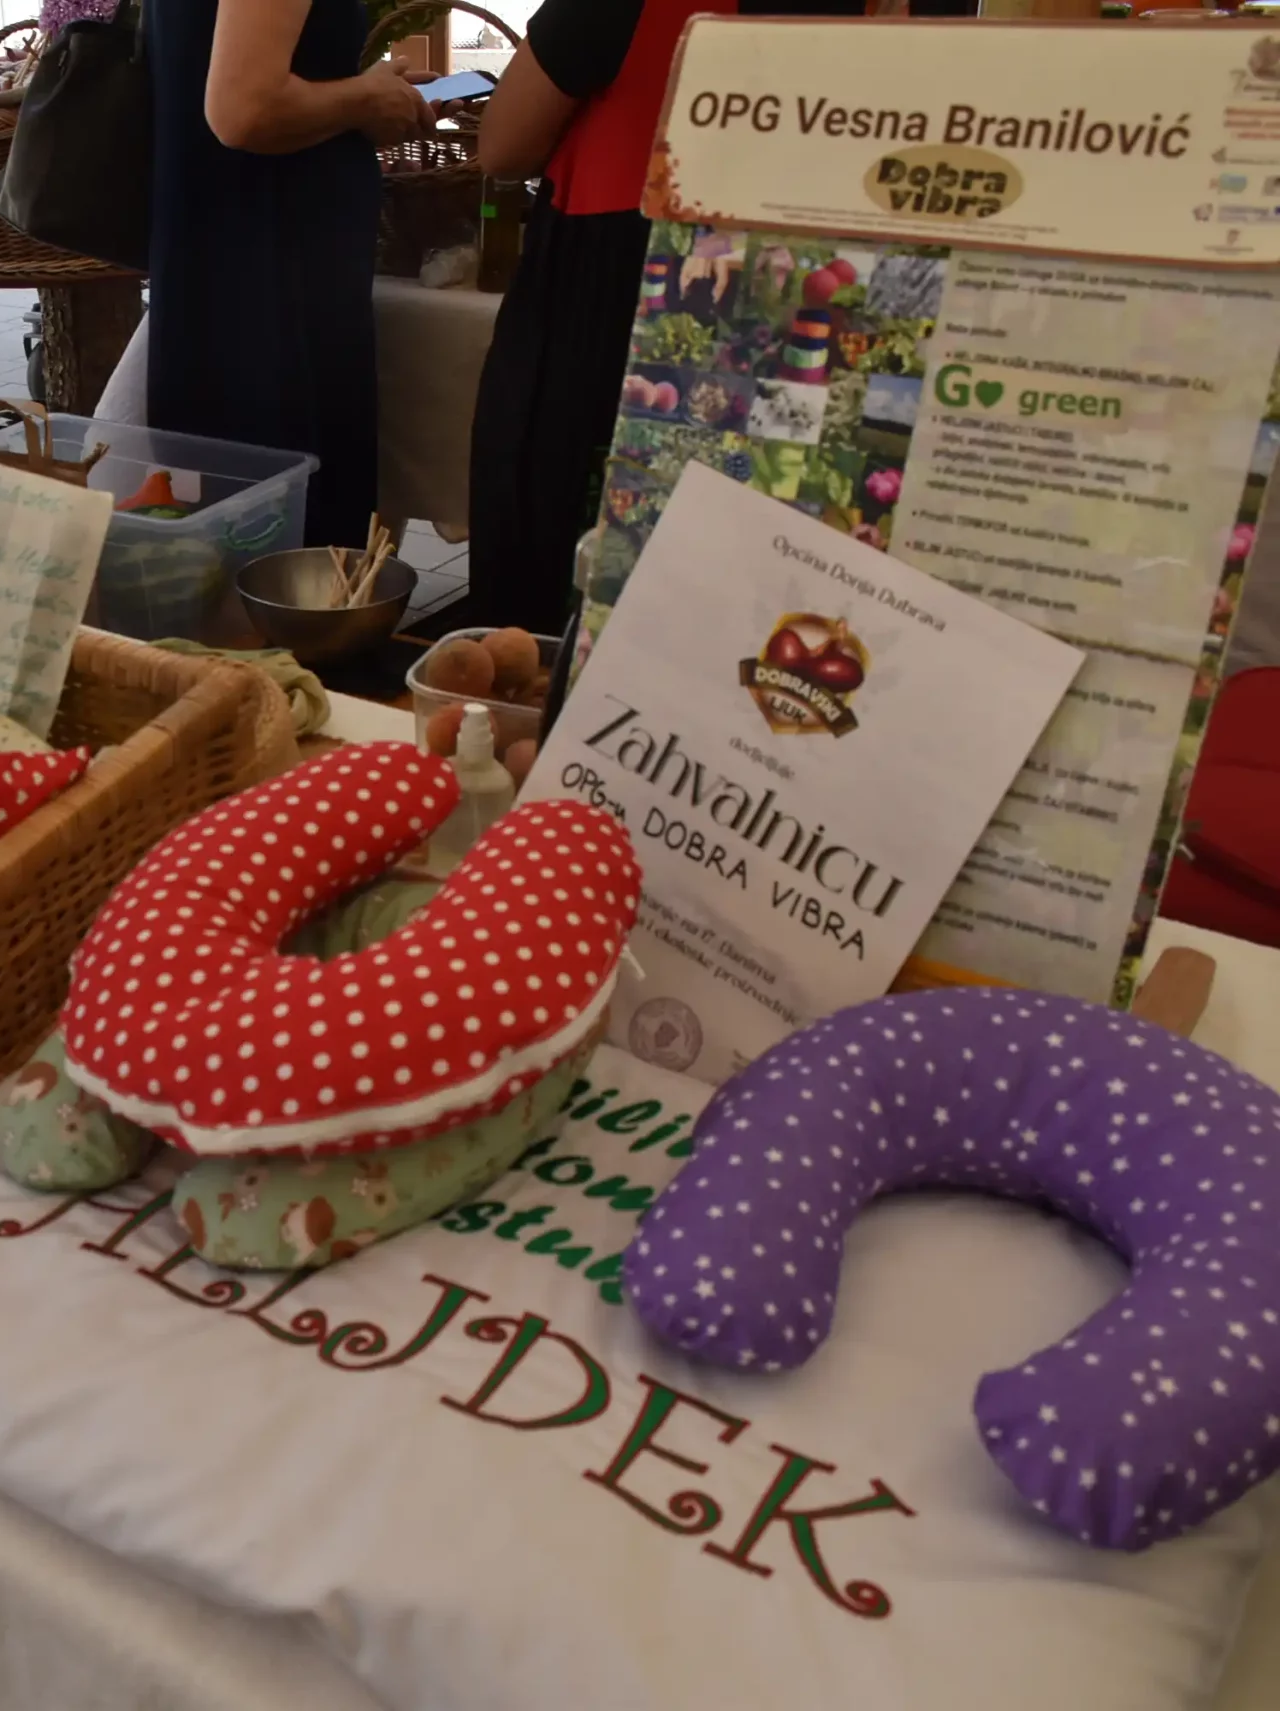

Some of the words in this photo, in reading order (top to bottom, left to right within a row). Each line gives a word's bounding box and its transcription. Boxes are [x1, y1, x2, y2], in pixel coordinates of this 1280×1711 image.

[688, 91, 782, 133] OPG
[796, 96, 928, 143] Vesna
[943, 104, 1192, 160] Branilović
[876, 157, 1009, 194] Dobra
[888, 184, 1003, 219] vibra
[1018, 388, 1122, 419] green
[829, 562, 876, 597] Donja
[878, 586, 947, 633] Dubrava
[583, 693, 905, 919] Zahvalnicu
[642, 806, 748, 890] DOBRA
[770, 880, 865, 961] VIBRA
